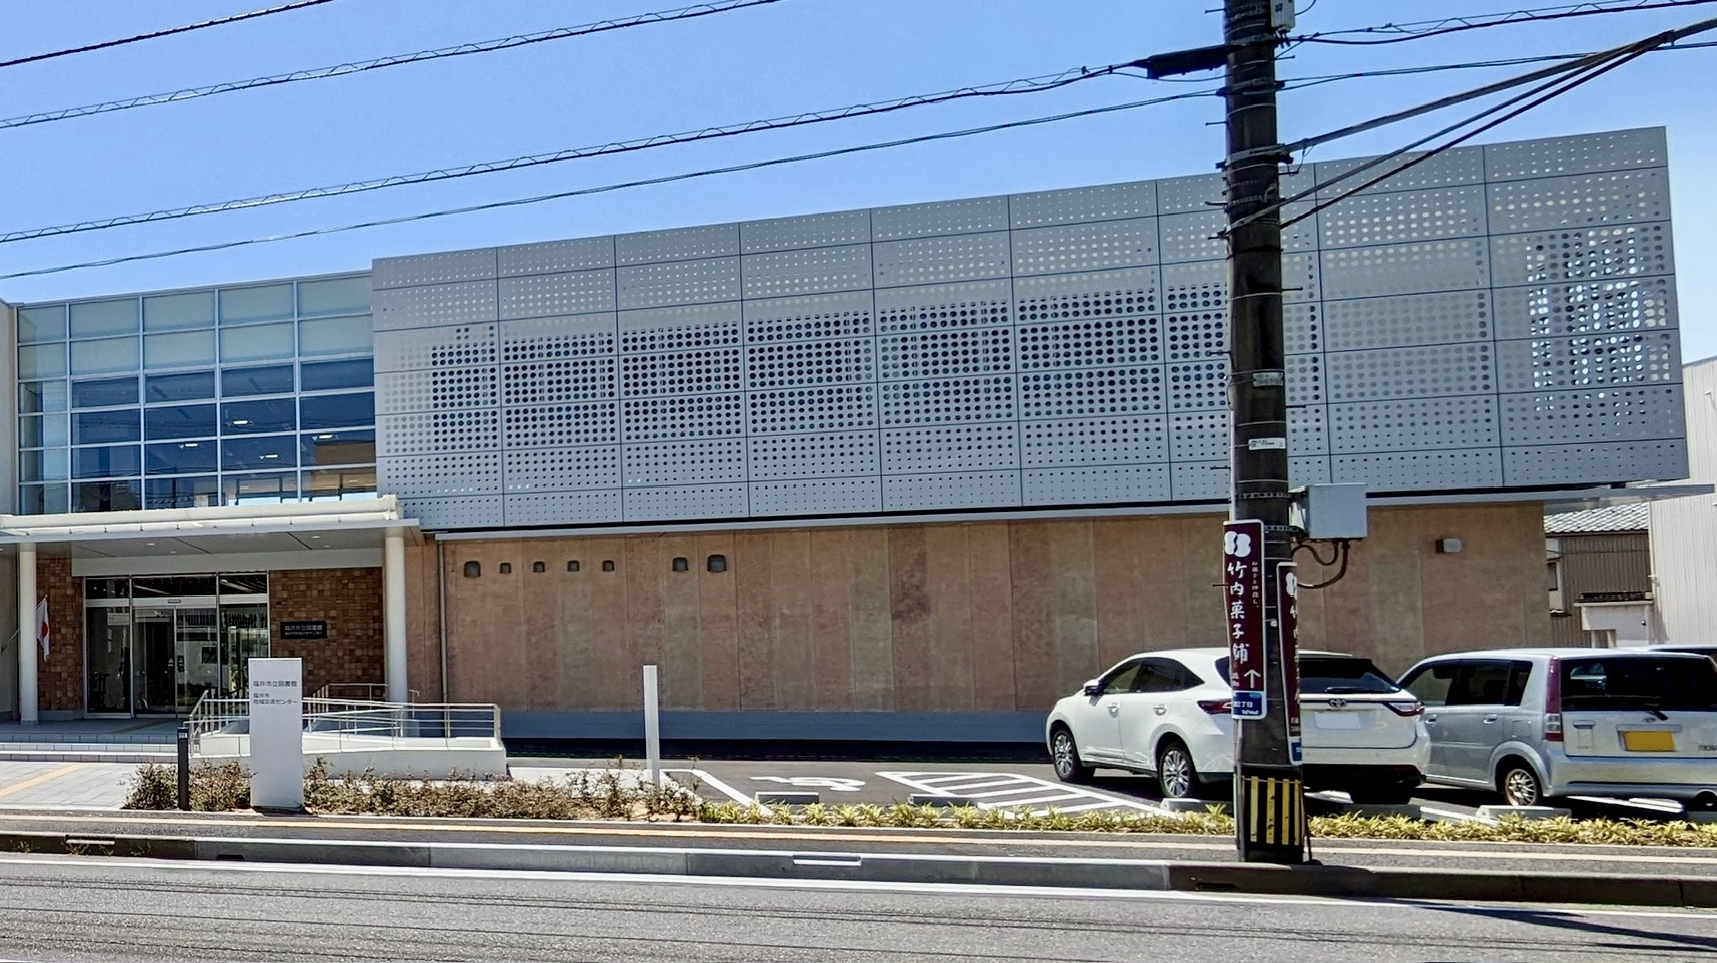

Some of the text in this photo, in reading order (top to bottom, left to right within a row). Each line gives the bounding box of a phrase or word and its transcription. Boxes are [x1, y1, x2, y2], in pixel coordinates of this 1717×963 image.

[1227, 561, 1249, 664] 竹内菓子舗
